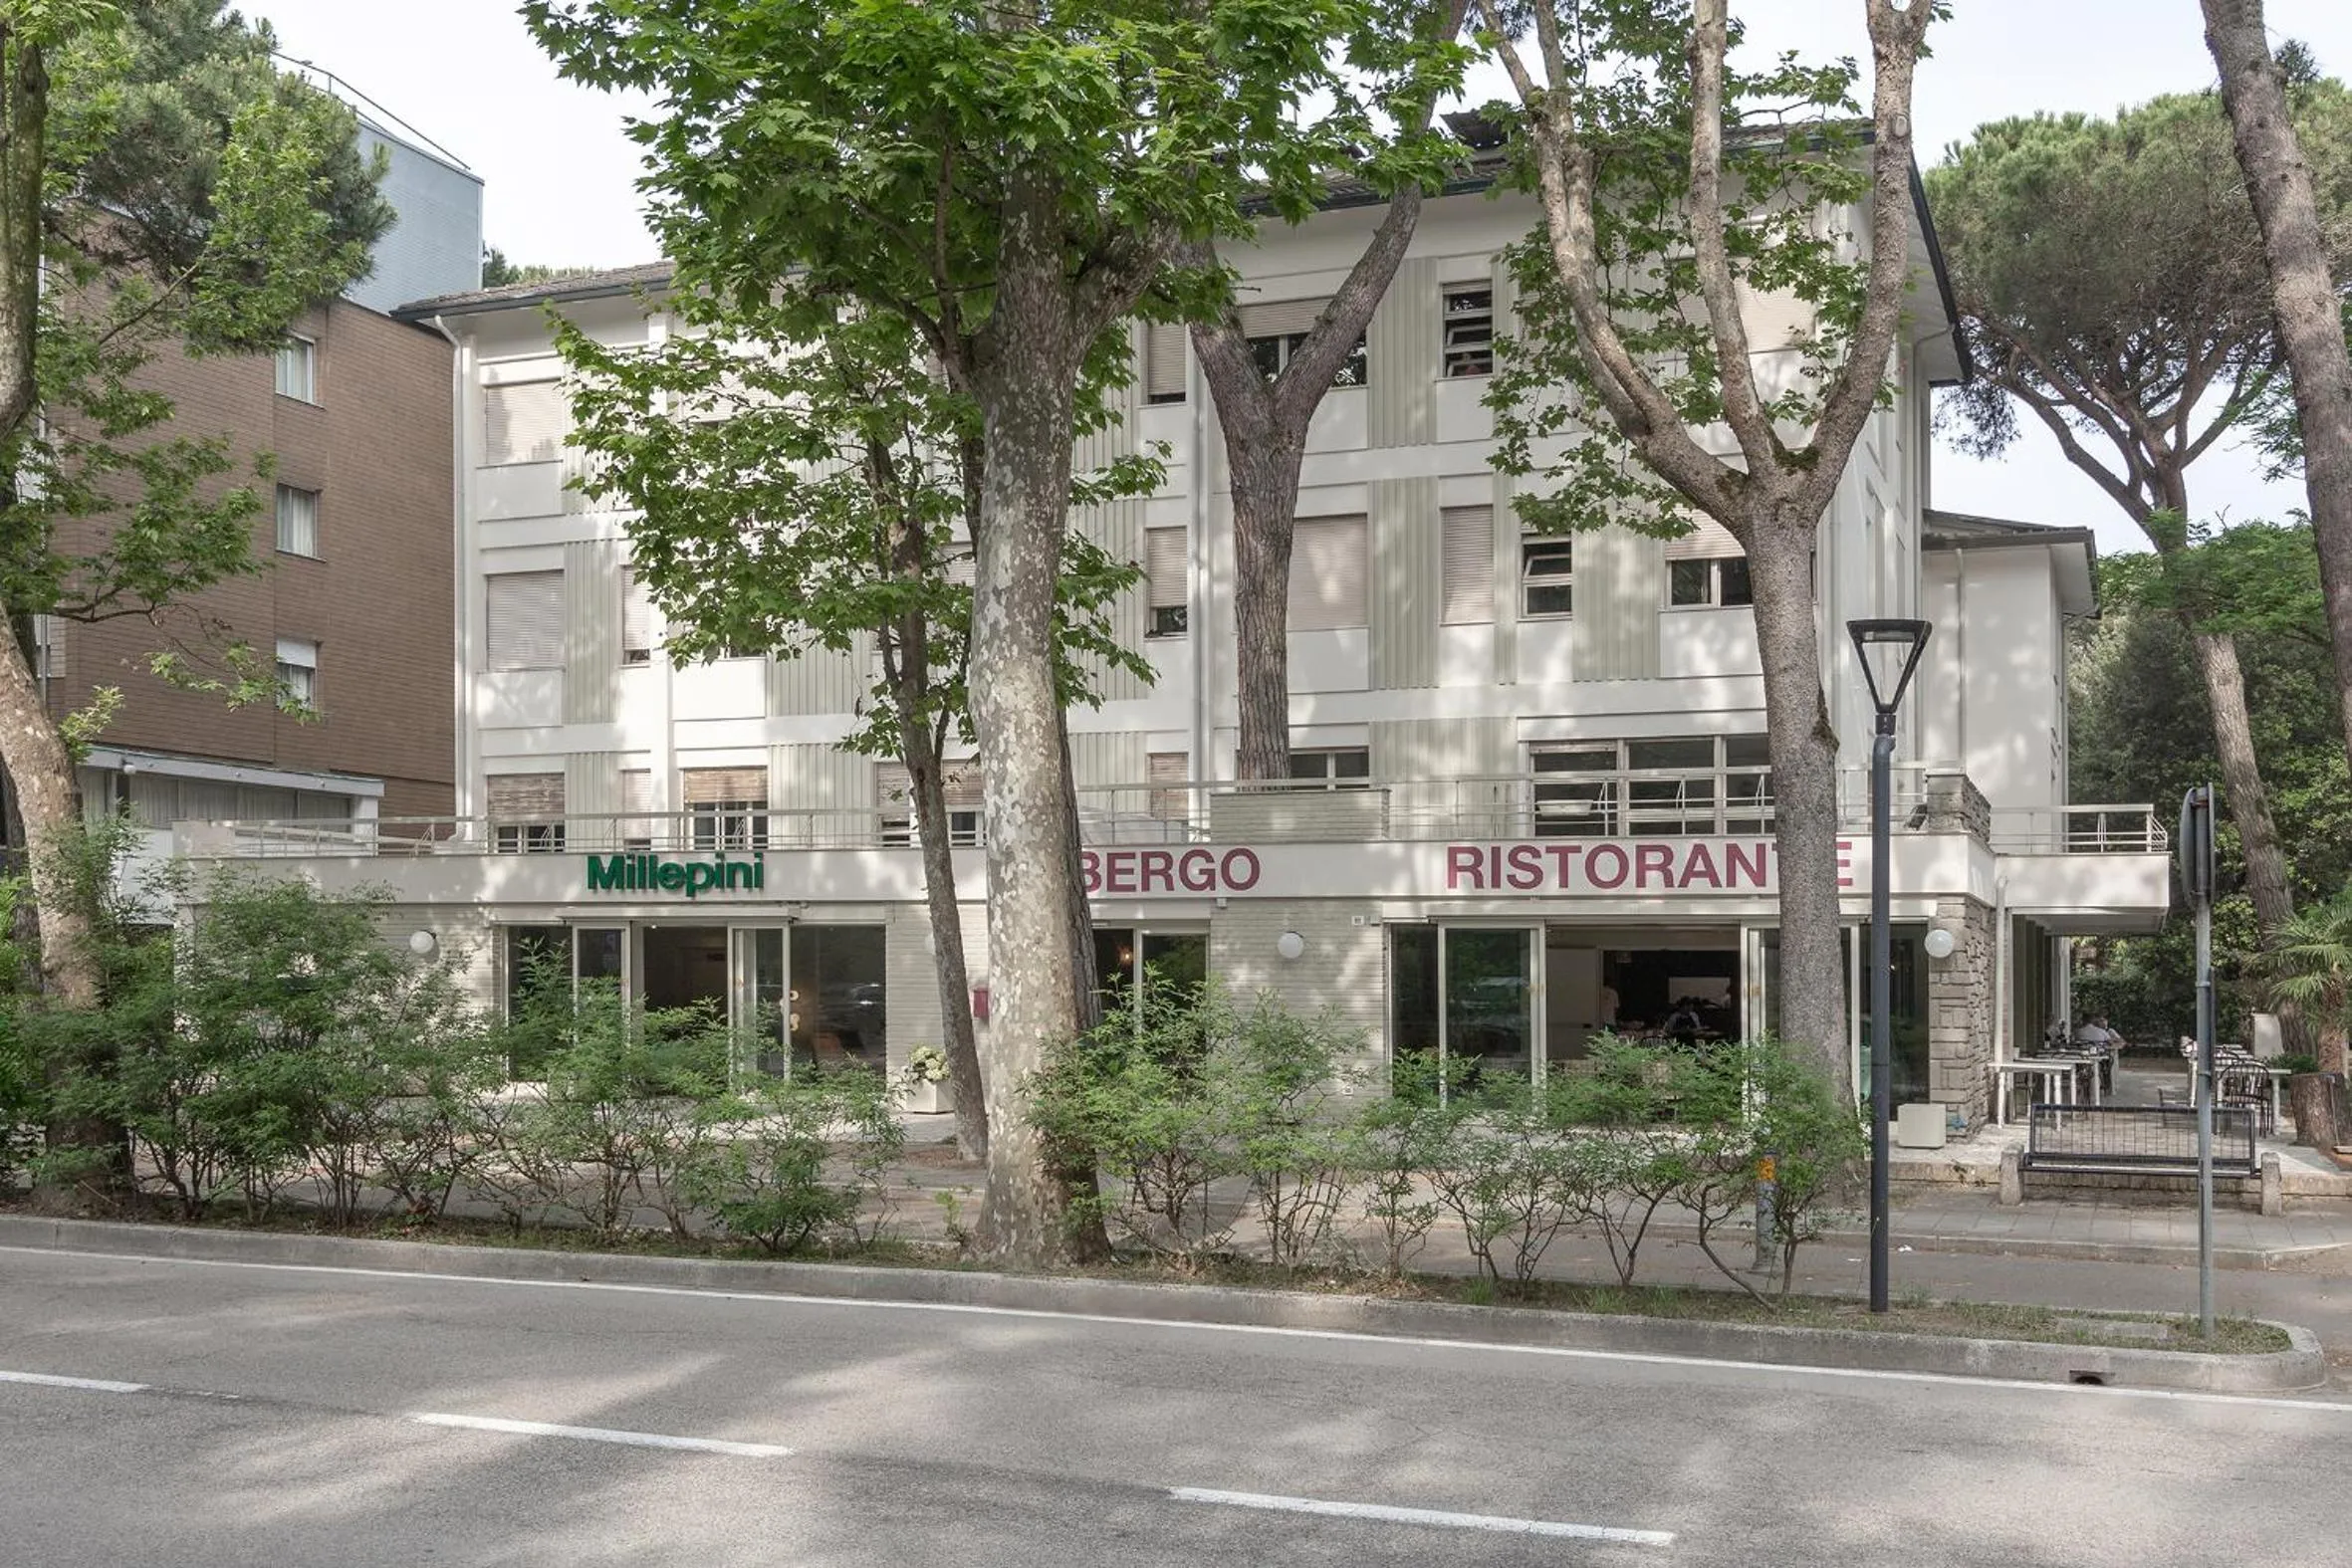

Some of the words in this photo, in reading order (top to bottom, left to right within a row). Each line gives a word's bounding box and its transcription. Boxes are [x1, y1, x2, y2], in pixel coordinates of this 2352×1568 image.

[588, 851, 765, 898] Millepini
[1080, 847, 1261, 893] BERGO
[1447, 841, 1854, 890] RISTORANE
